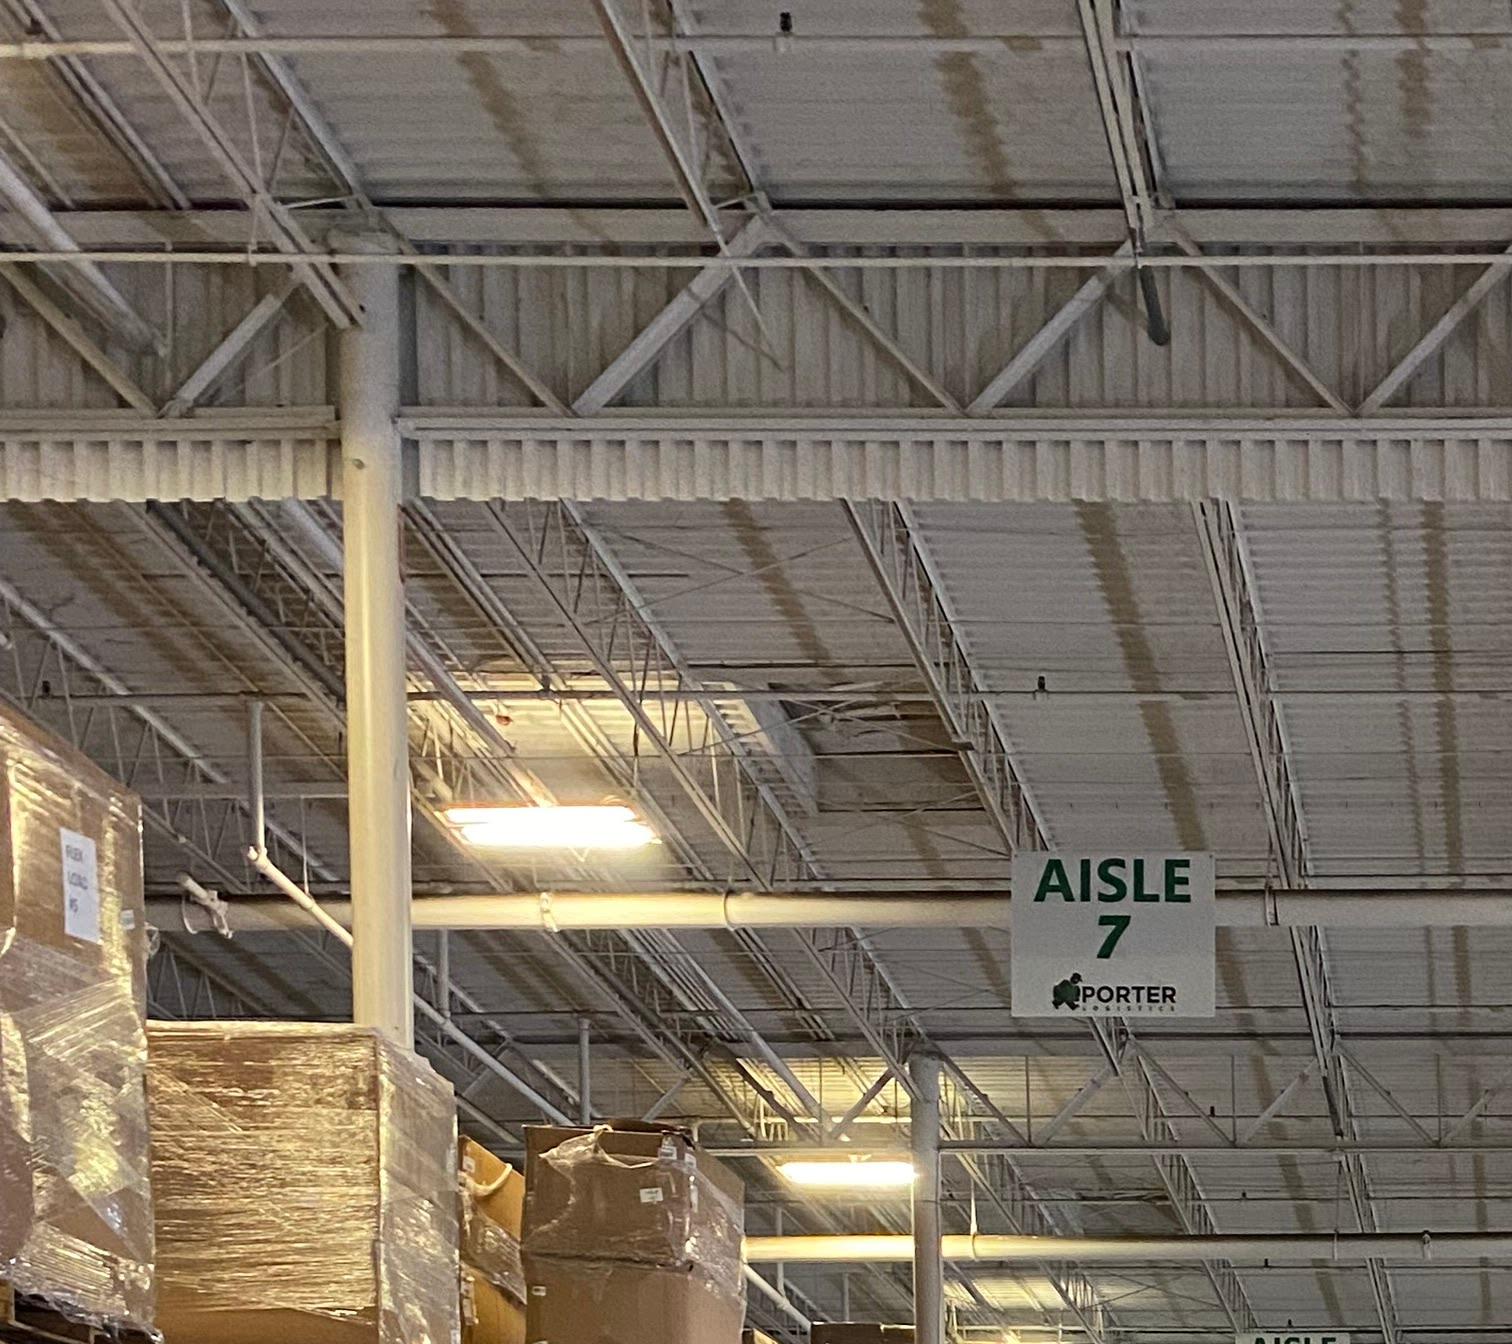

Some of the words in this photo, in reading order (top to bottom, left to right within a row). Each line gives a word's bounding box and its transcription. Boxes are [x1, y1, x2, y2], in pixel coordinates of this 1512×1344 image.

[1033, 858, 1192, 903] AISLE
[1096, 915, 1132, 959] 7
[1081, 986, 1177, 1004] PORTER
